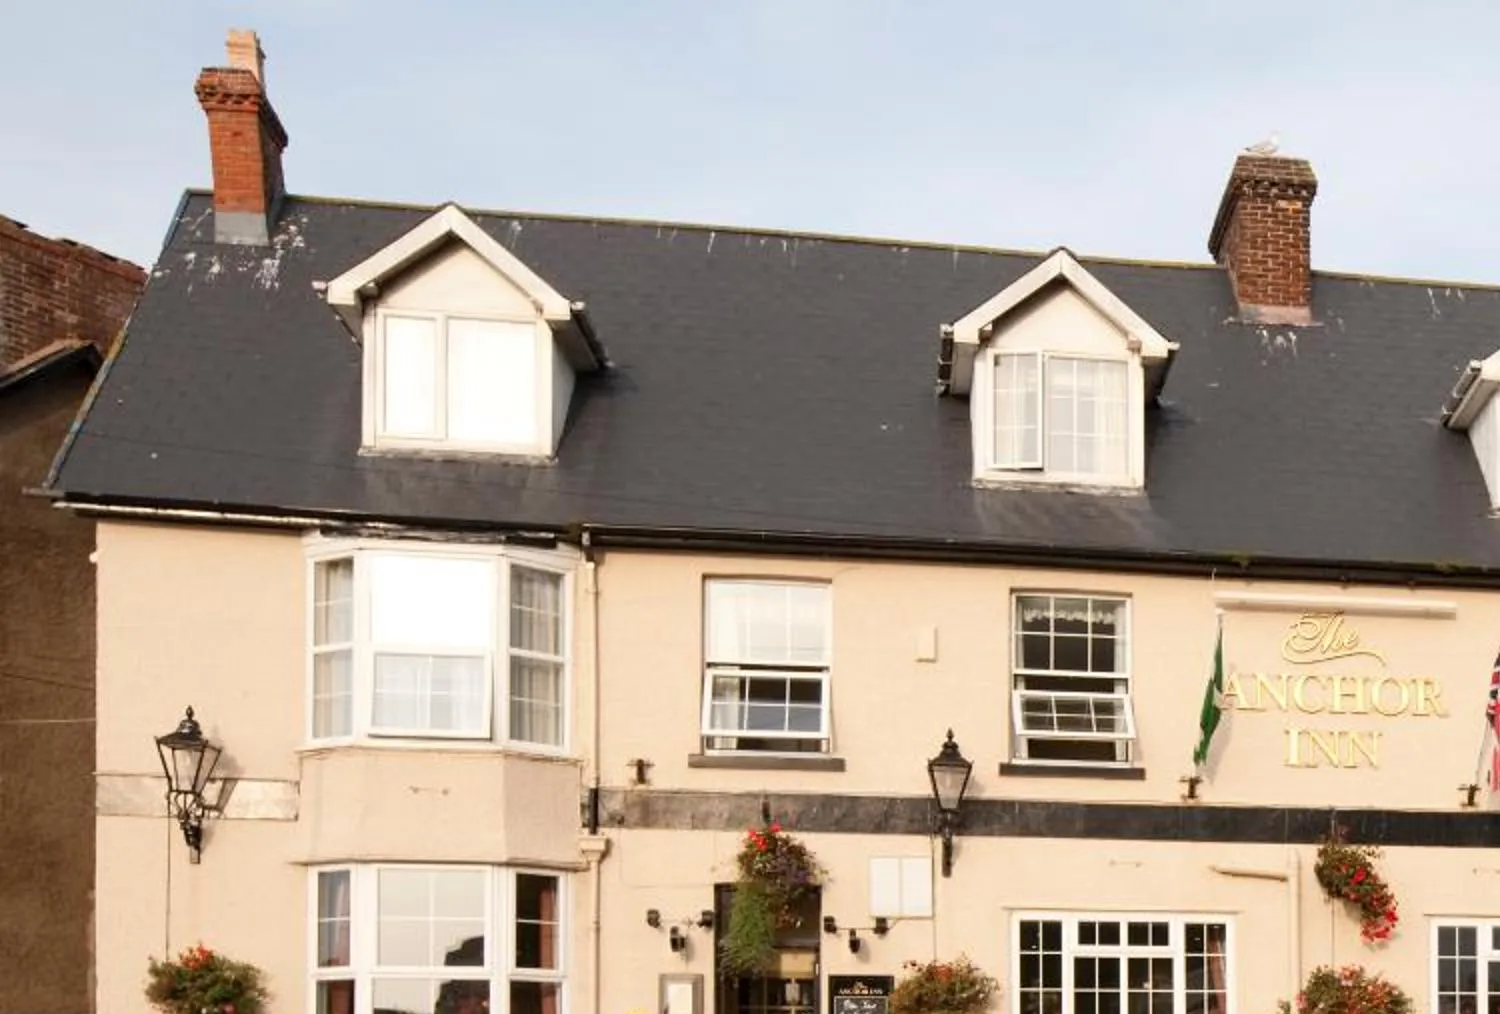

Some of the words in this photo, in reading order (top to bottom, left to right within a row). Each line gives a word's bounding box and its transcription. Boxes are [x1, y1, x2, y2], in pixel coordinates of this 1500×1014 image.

[1282, 608, 1387, 667] The
[1222, 672, 1451, 718] ANCHOR
[1284, 727, 1383, 769] INN
